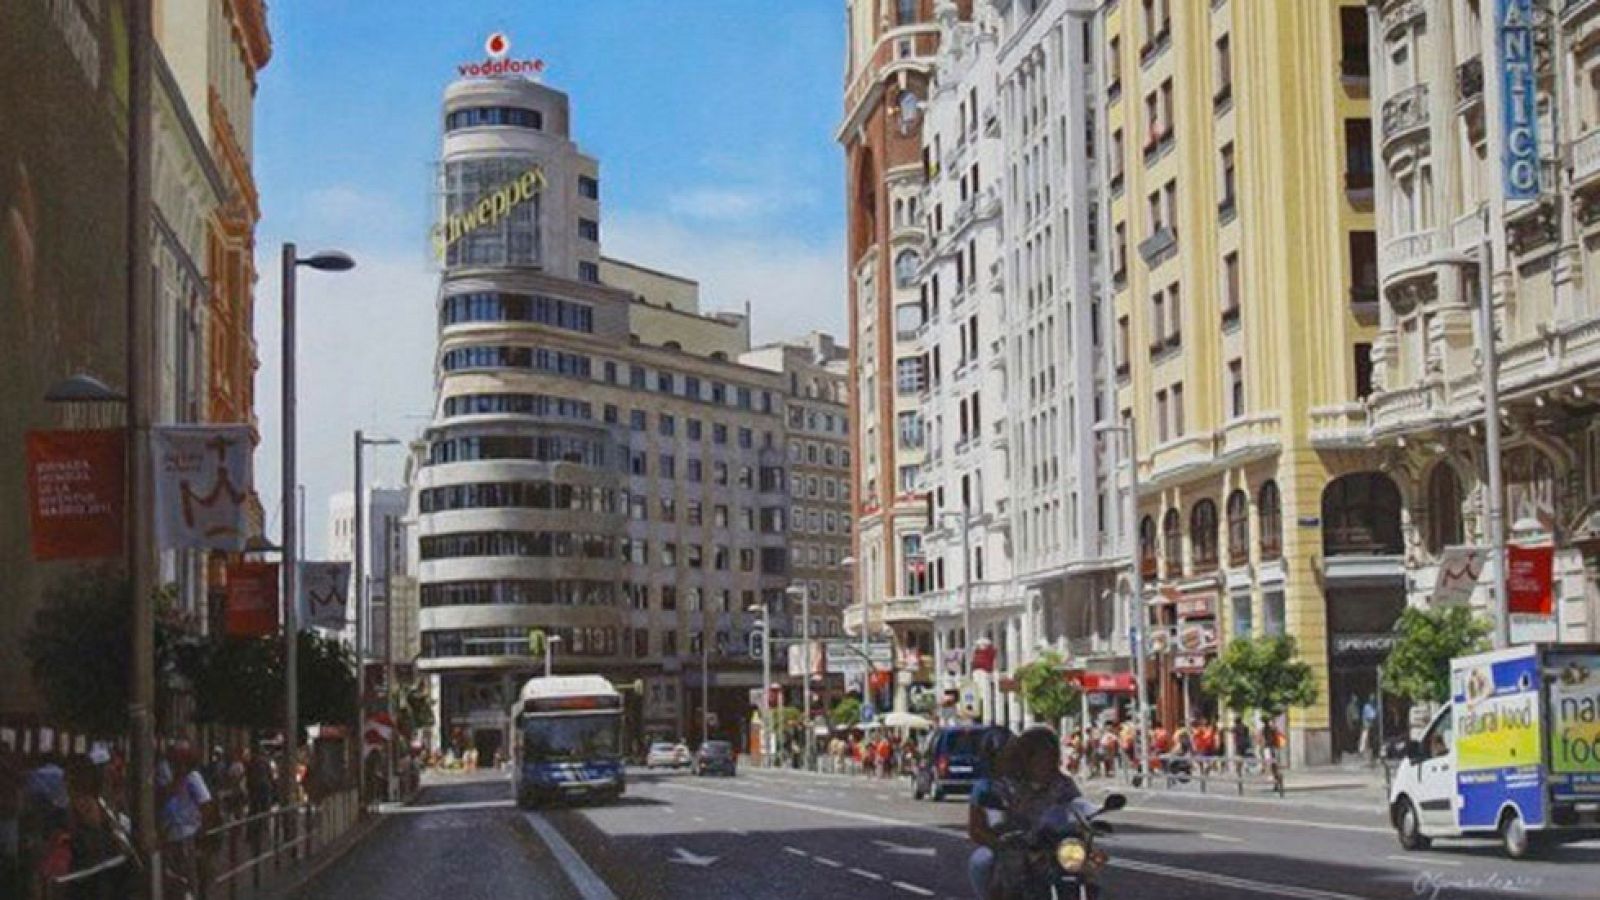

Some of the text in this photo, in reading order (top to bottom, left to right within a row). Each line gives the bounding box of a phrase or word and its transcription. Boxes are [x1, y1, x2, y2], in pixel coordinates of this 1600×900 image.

[458, 57, 546, 76] vodafone
[431, 165, 548, 258] Shweppes
[1458, 698, 1532, 736] natural food
